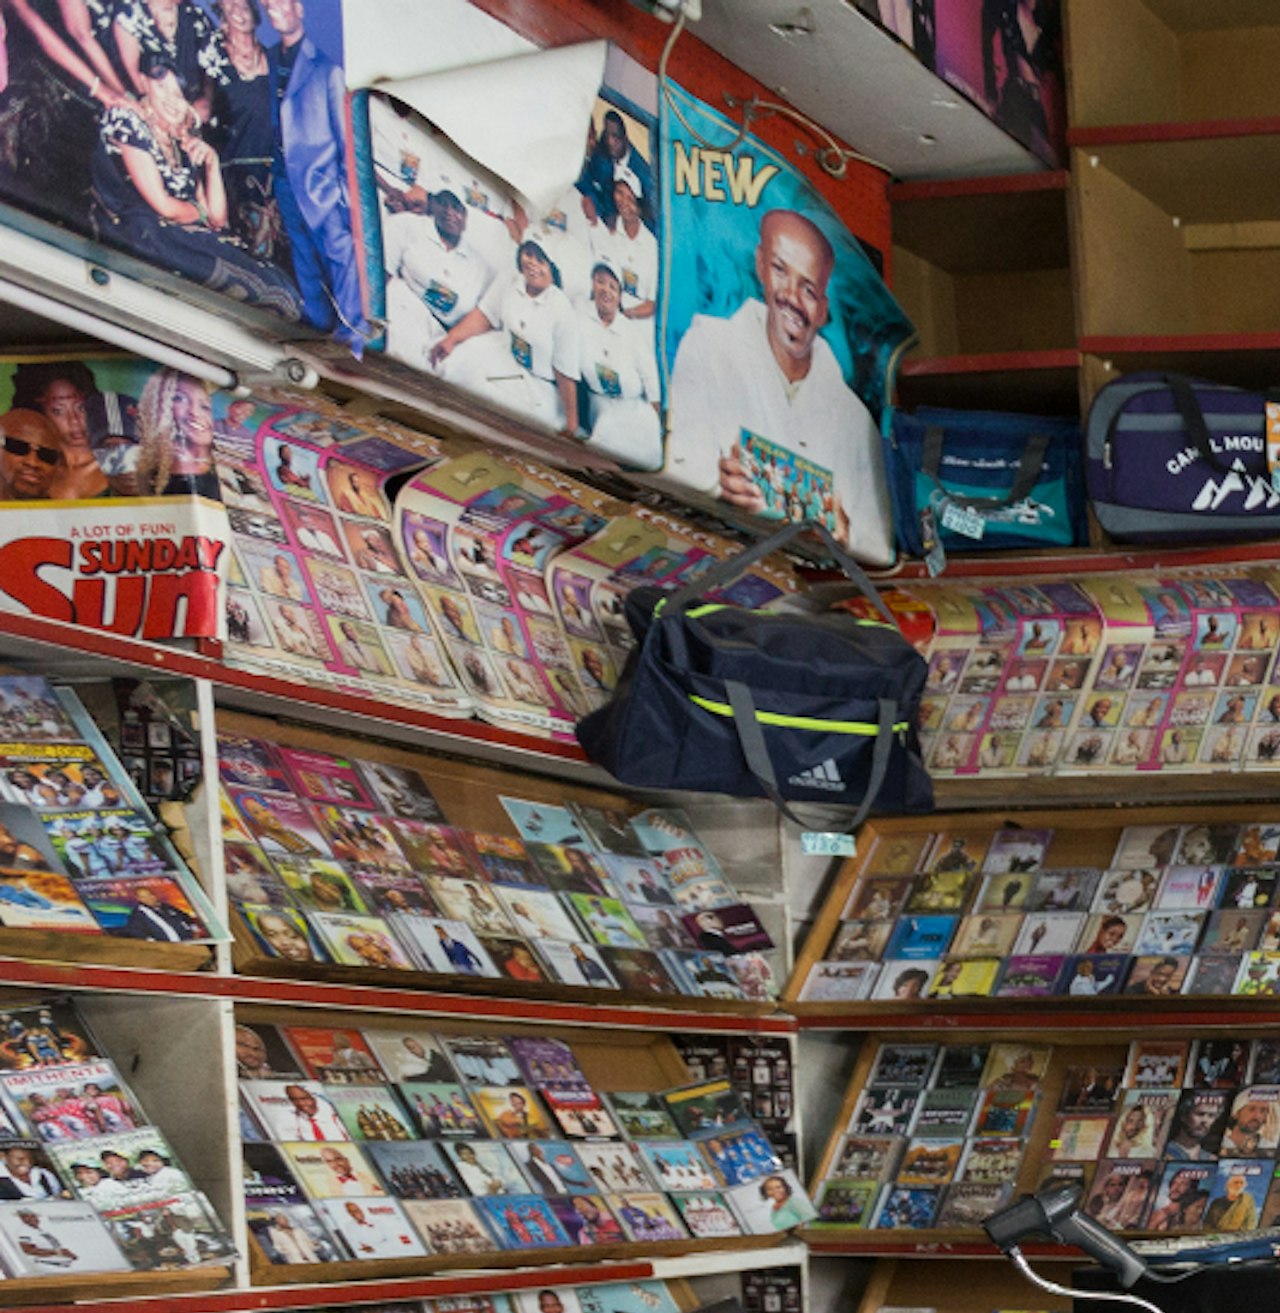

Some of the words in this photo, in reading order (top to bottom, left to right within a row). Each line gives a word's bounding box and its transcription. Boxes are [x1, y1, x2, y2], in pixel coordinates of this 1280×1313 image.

[673, 140, 781, 209] NEW
[70, 527, 82, 539] A
[84, 525, 110, 539] LOT
[115, 524, 134, 536] OF
[79, 536, 225, 575] SUNDAY
